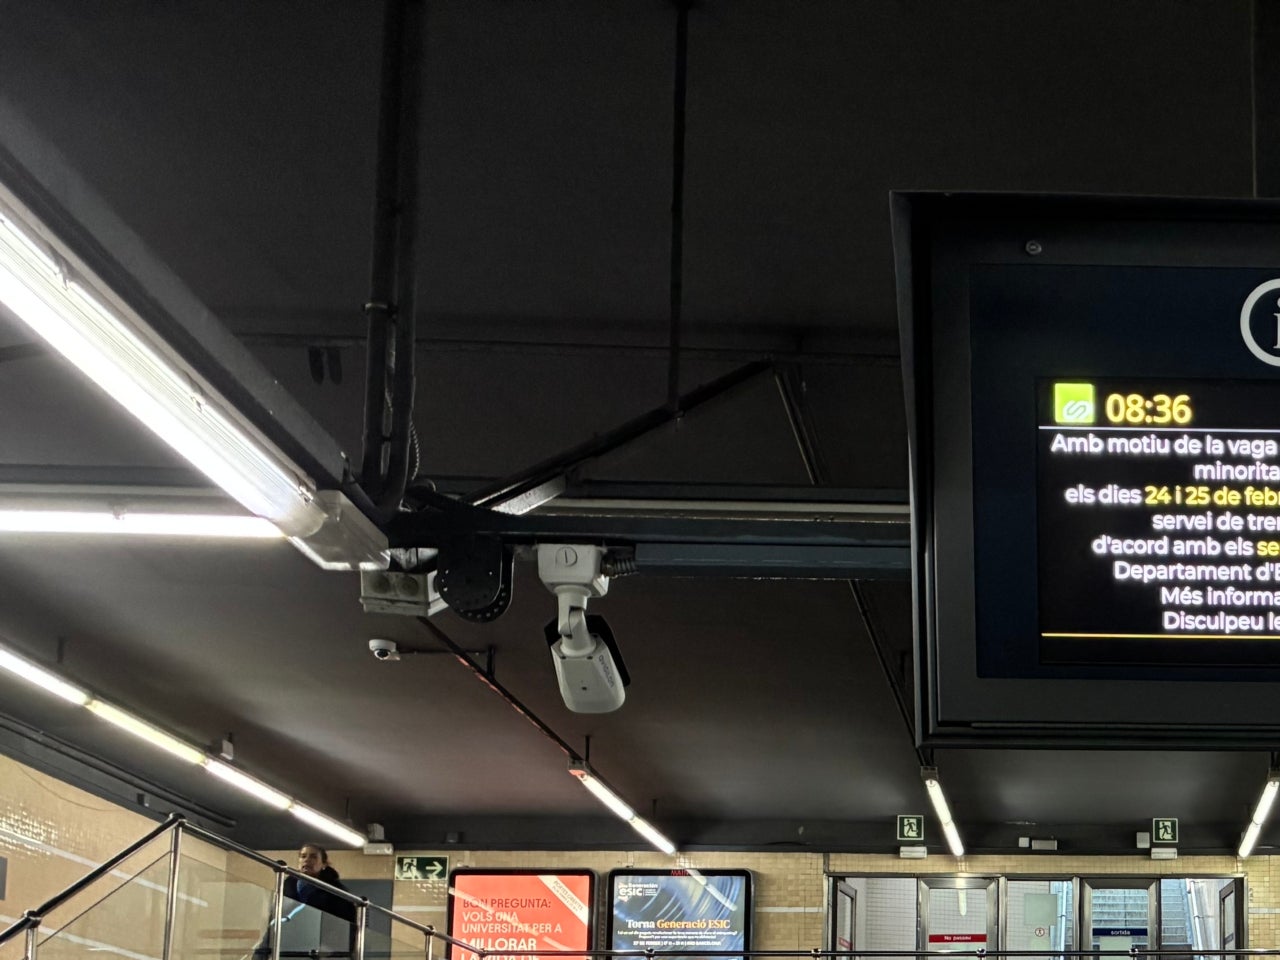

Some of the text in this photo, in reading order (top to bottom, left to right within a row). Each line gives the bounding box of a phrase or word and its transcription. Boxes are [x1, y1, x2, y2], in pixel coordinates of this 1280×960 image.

[1106, 394, 1192, 423] 08:36
[1051, 433, 1104, 454] Amb
[1108, 434, 1170, 454] motiu
[1174, 435, 1202, 454] de
[1206, 435, 1224, 455] la
[1227, 440, 1278, 459] vaga
[1064, 484, 1095, 503] els
[1098, 484, 1142, 504] dies
[1145, 486, 1171, 504] 24
[1175, 485, 1181, 504] i
[1185, 486, 1210, 505] 25
[1213, 486, 1241, 505] de
[1152, 511, 1212, 530] servei
[1216, 511, 1244, 530] de
[1091, 535, 1169, 554] d'acord
[1173, 536, 1221, 555] amb
[1225, 537, 1254, 556] els
[1113, 561, 1252, 583] Departament
[1160, 586, 1203, 605] Més
[1163, 611, 1264, 634] Disculpeu
[491, 899, 551, 908] PREGUNTA:
[463, 912, 492, 922] VOLS
[626, 919, 731, 929] Torna Generació ESIC
[462, 923, 562, 933] UNIVERSITAT PER A
[460, 938, 536, 951] MILLORAR
